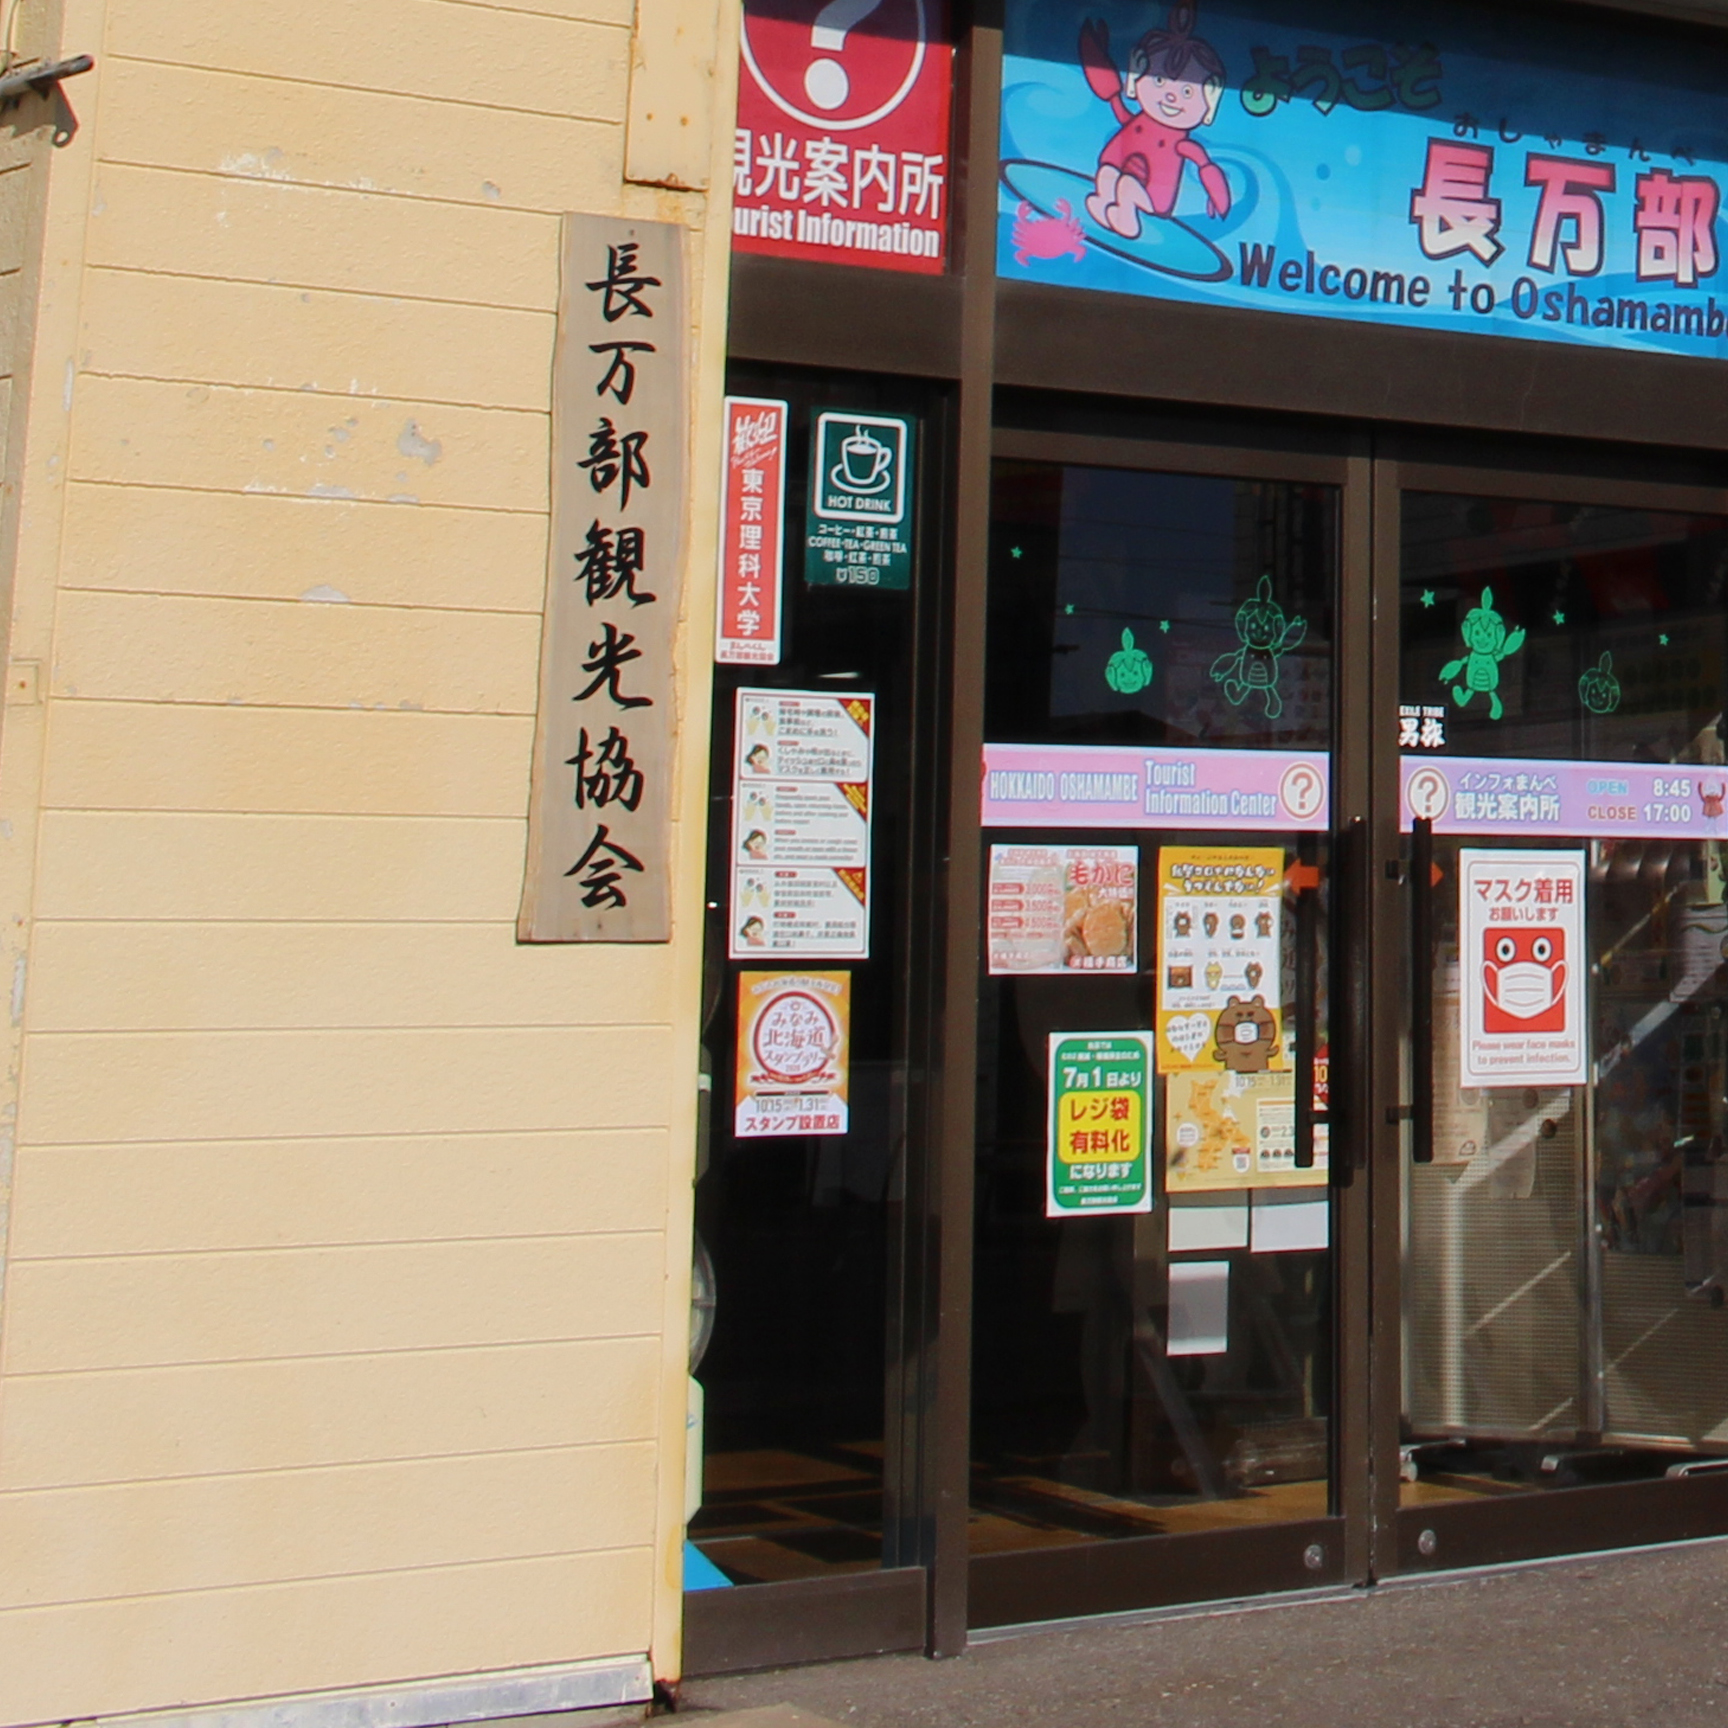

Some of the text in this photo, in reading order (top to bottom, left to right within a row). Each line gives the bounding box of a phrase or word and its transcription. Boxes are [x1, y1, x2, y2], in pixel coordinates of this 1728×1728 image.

[1240, 42, 1442, 117] ようこそ
[1452, 111, 1697, 165] おしゃまんべ
[1409, 135, 1721, 289] 長万部
[733, 204, 940, 258] urist Information
[1237, 241, 1430, 308] Welcome
[1448, 268, 1496, 315] to
[827, 494, 892, 512] HOT DRINK
[737, 468, 765, 637] 東京理科大学
[563, 241, 664, 914] 長万部観光協会
[989, 770, 1139, 803] HOKKAIDO OSHAMAMBE
[1145, 759, 1196, 788] Tourist
[1459, 771, 1558, 791] インフォまんべ
[1586, 778, 1692, 798] OPEN 8:45
[1145, 788, 1278, 818] Information Center
[1454, 792, 1561, 822] 観光案内所
[1587, 804, 1693, 823] CLOSE 17:00
[1474, 877, 1574, 904] マスク着用
[1489, 906, 1559, 923] お願いします
[763, 1027, 826, 1049] 北海道
[1472, 1040, 1501, 1051] Please
[1526, 1039, 1547, 1050] face
[1063, 1065, 1142, 1089] 7月1日より
[1071, 1097, 1131, 1121] レジ袋
[745, 1114, 841, 1132] スタンプ設置店
[1069, 1129, 1131, 1155] 有料化
[1069, 1162, 1134, 1180] になります
